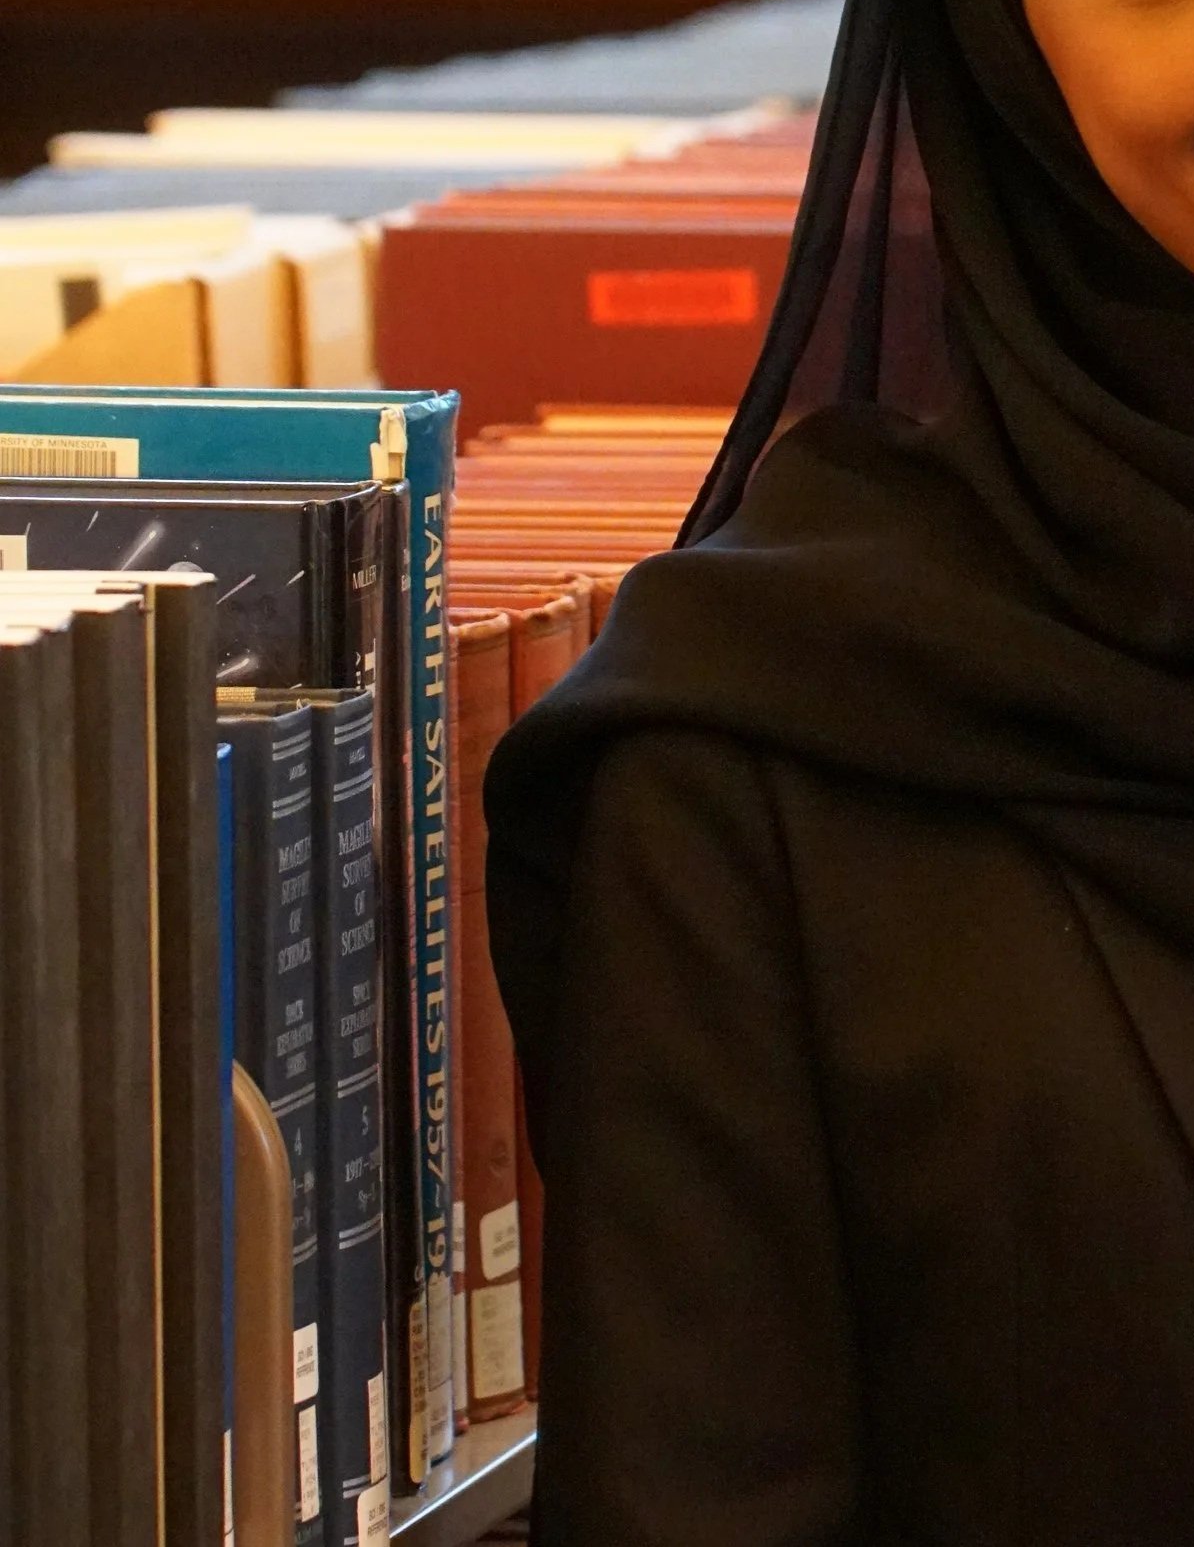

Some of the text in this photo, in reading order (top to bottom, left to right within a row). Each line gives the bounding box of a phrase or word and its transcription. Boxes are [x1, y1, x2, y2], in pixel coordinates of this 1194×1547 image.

[0, 437, 108, 449] RSITY OF MINNESOTA
[352, 564, 377, 590] MILLER
[424, 492, 443, 697] EARTH
[425, 717, 447, 1053] SATELLITES
[341, 918, 375, 957] SCIENC
[361, 1105, 369, 1136] 5
[294, 1128, 303, 1156] 4
